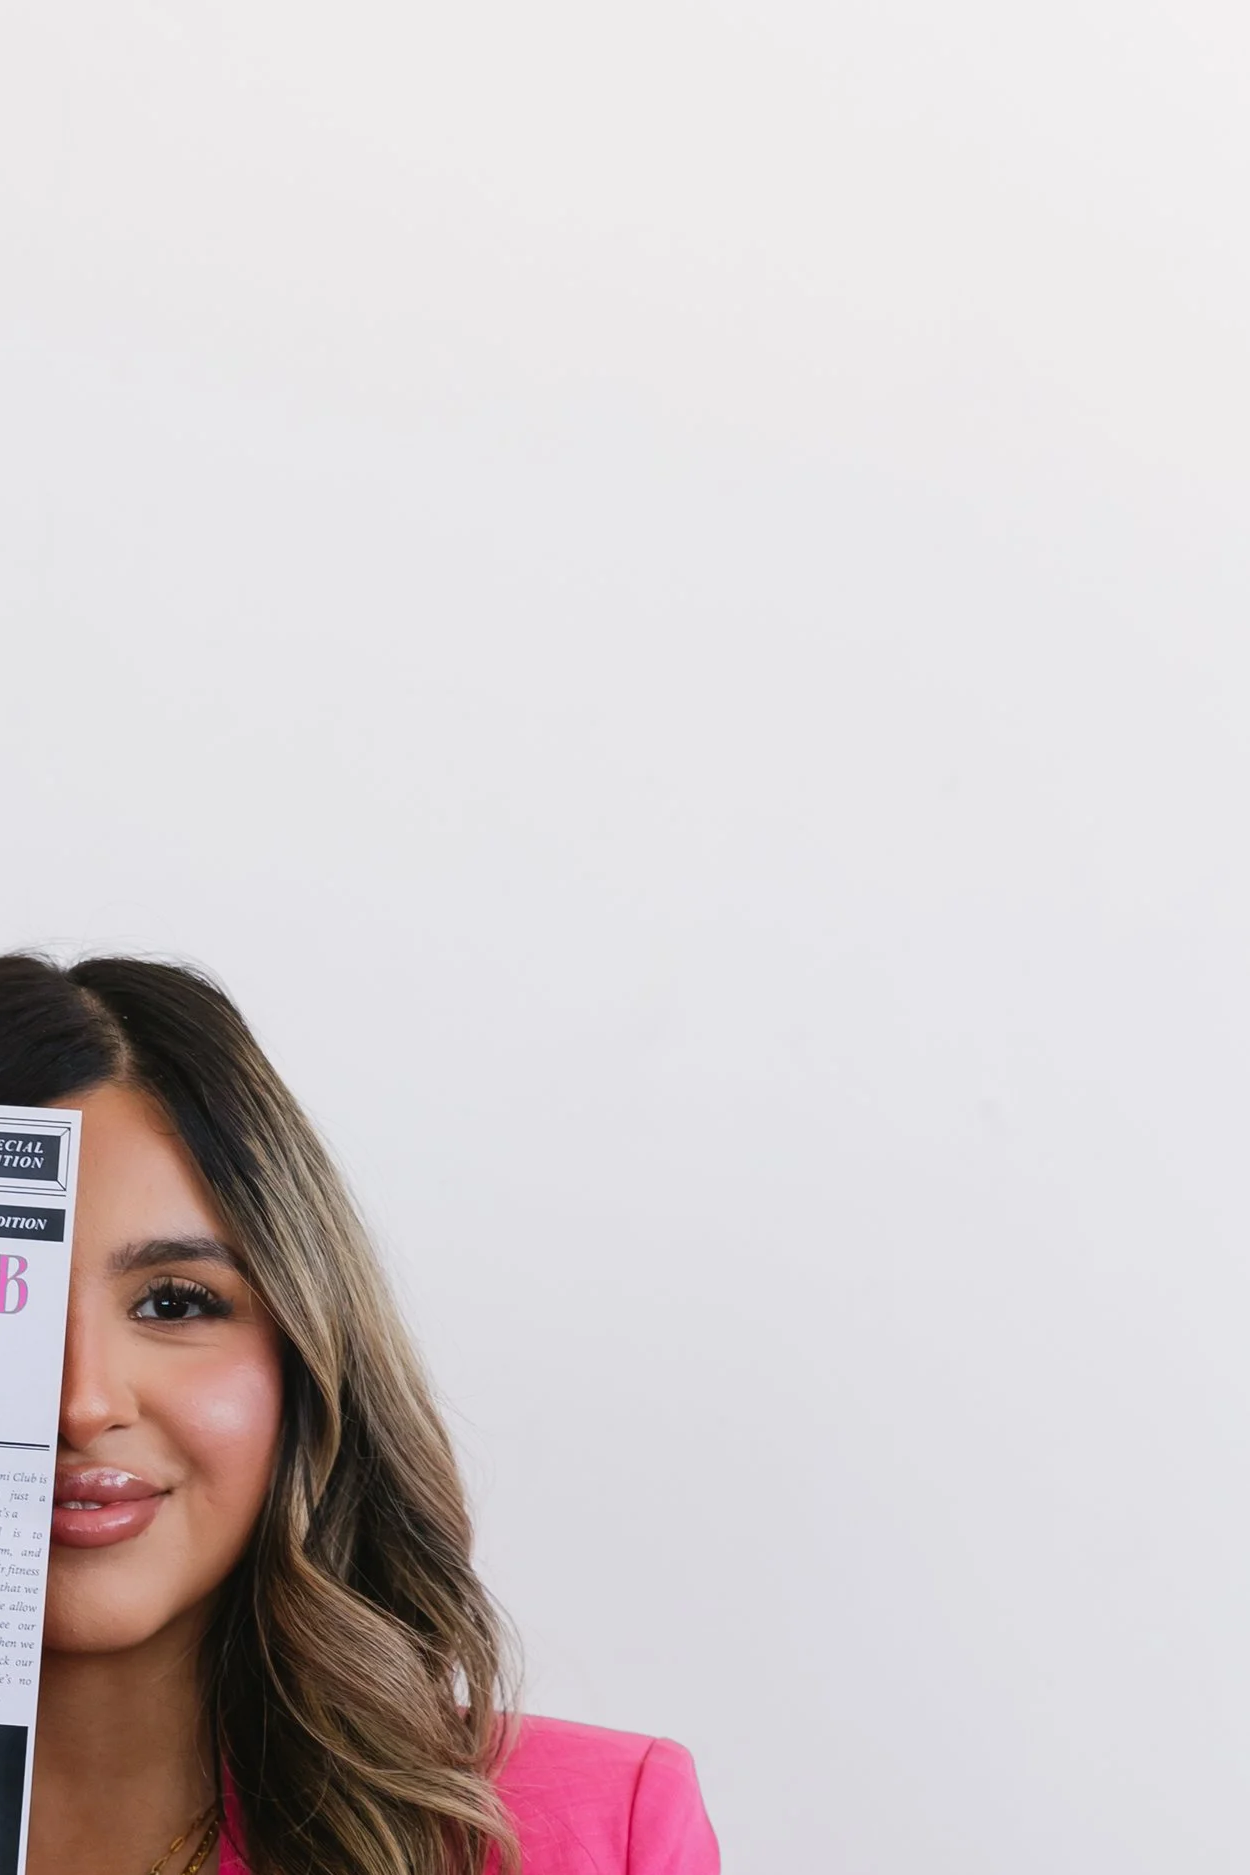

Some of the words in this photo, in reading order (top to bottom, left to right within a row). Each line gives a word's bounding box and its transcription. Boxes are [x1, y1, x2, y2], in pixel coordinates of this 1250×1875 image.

[12, 1472, 37, 1484] Club
[39, 1476, 48, 1484] is
[9, 1490, 29, 1501] just
[39, 1494, 46, 1502] a
[11, 1510, 19, 1519] a
[13, 1529, 21, 1538] is
[32, 1531, 43, 1540] to
[21, 1548, 42, 1558] and
[6, 1563, 40, 1576] fitness
[0, 1582, 21, 1593] that
[24, 1587, 39, 1595] we
[9, 1602, 38, 1613] allow
[18, 1623, 37, 1631] our
[20, 1641, 35, 1650] we
[15, 1659, 34, 1667] our
[18, 1677, 32, 1686] no
